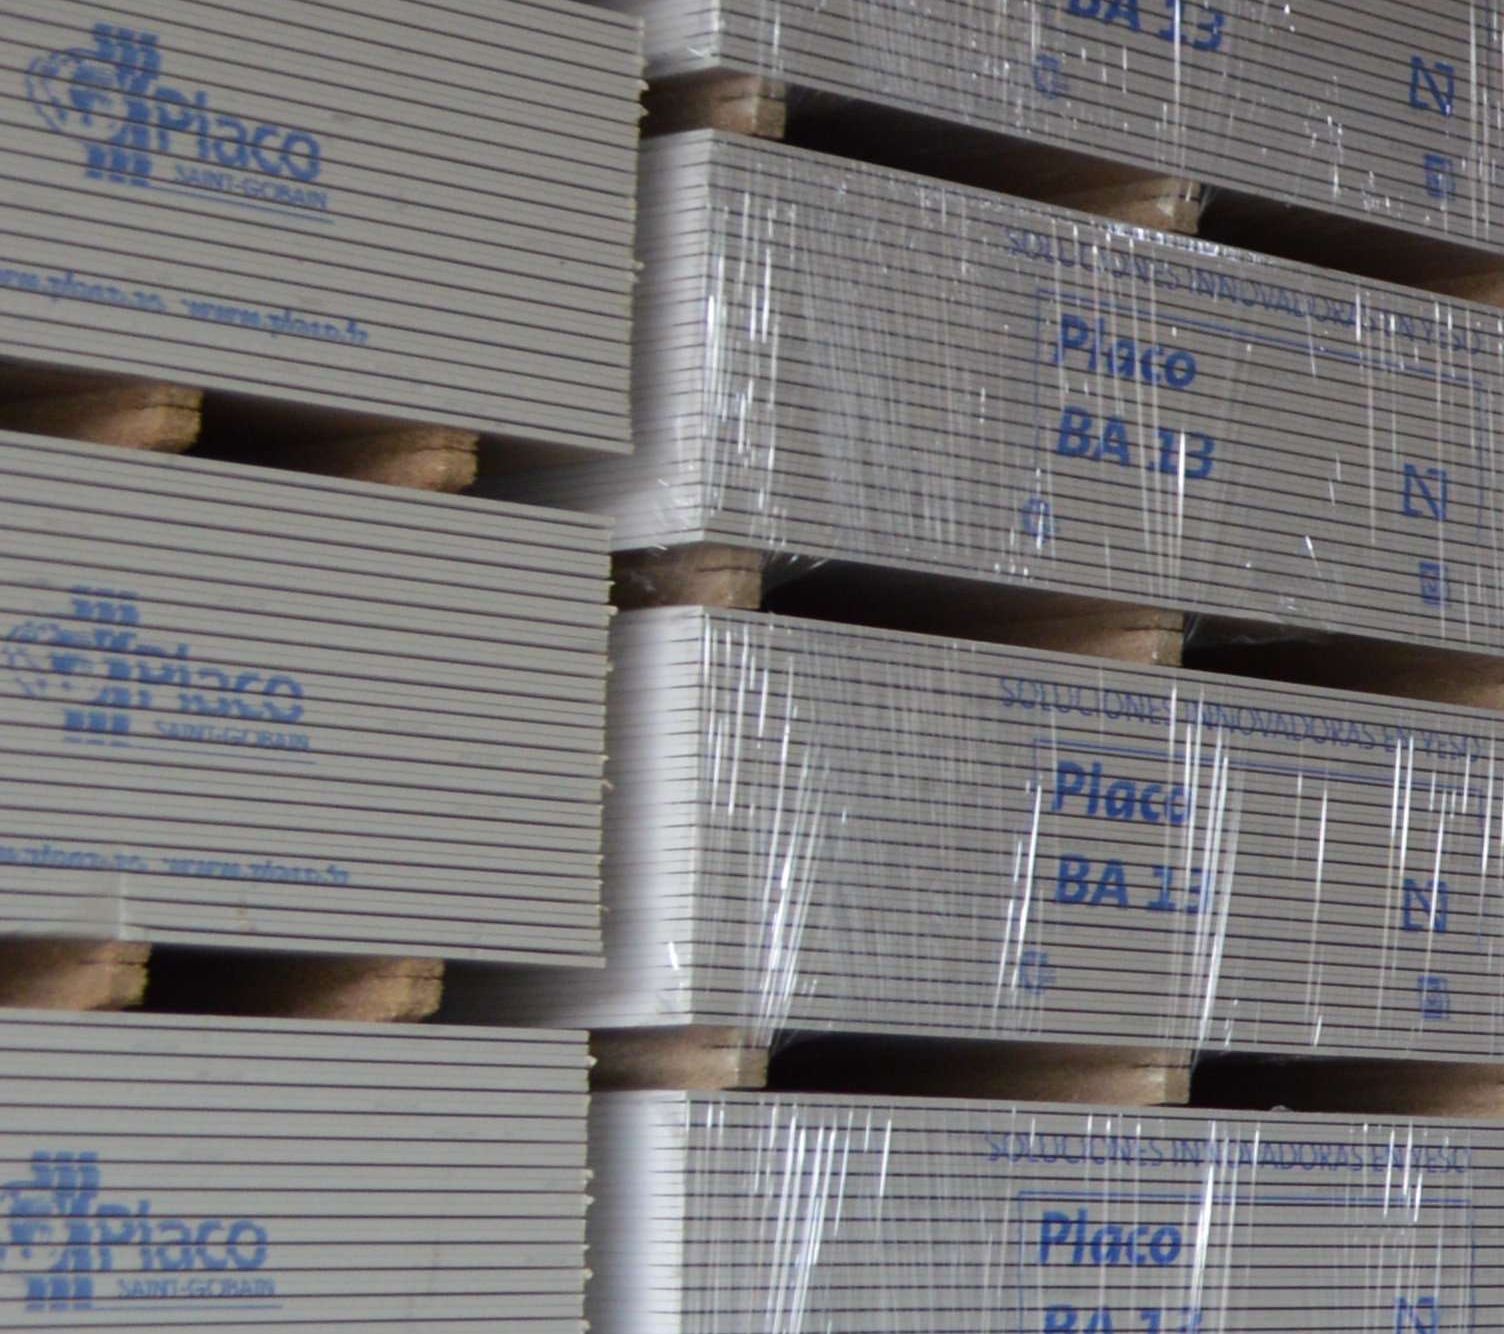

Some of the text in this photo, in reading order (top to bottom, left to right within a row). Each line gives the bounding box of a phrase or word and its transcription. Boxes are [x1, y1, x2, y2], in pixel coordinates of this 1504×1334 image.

[152, 85, 323, 183] Placo
[174, 163, 329, 211] SAINT-GOBAIN
[1053, 314, 1198, 389] Placo
[1056, 406, 1217, 481] BA 13
[132, 639, 306, 725] Placo
[1000, 676, 1174, 728] SOLUCIONES
[1184, 699, 1376, 753] INNOVADORAS
[1423, 731, 1483, 765] YESO
[1052, 759, 1194, 828] Placo
[1054, 852, 1214, 916] BA 13
[986, 1133, 1163, 1168] SOLUCIONES
[98, 1201, 269, 1272] Placo
[1038, 1208, 1184, 1266] Placo
[117, 1277, 276, 1300] SAINT-GOBAIN
